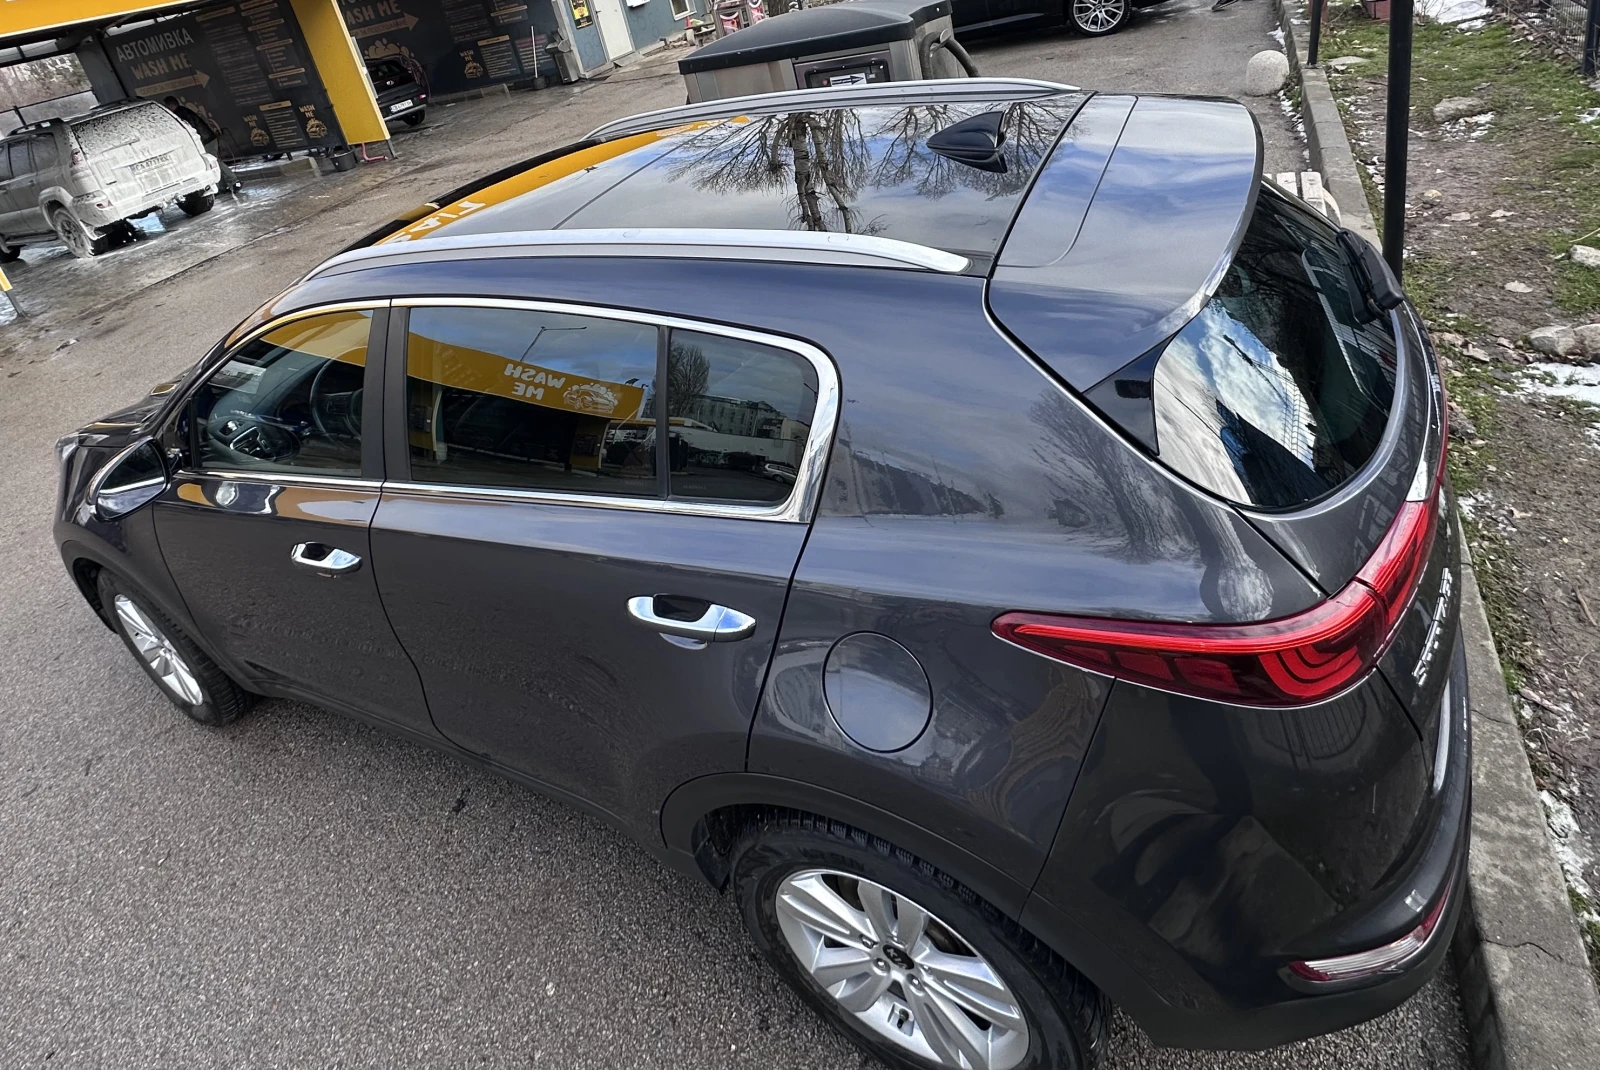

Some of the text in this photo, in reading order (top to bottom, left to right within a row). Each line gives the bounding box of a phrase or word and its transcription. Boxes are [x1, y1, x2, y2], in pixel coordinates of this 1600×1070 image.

[346, 0, 401, 26] ASH ME
[116, 28, 194, 62] АВТОМИВКА
[131, 52, 191, 80] WASH ME
[298, 104, 315, 112] WASH
